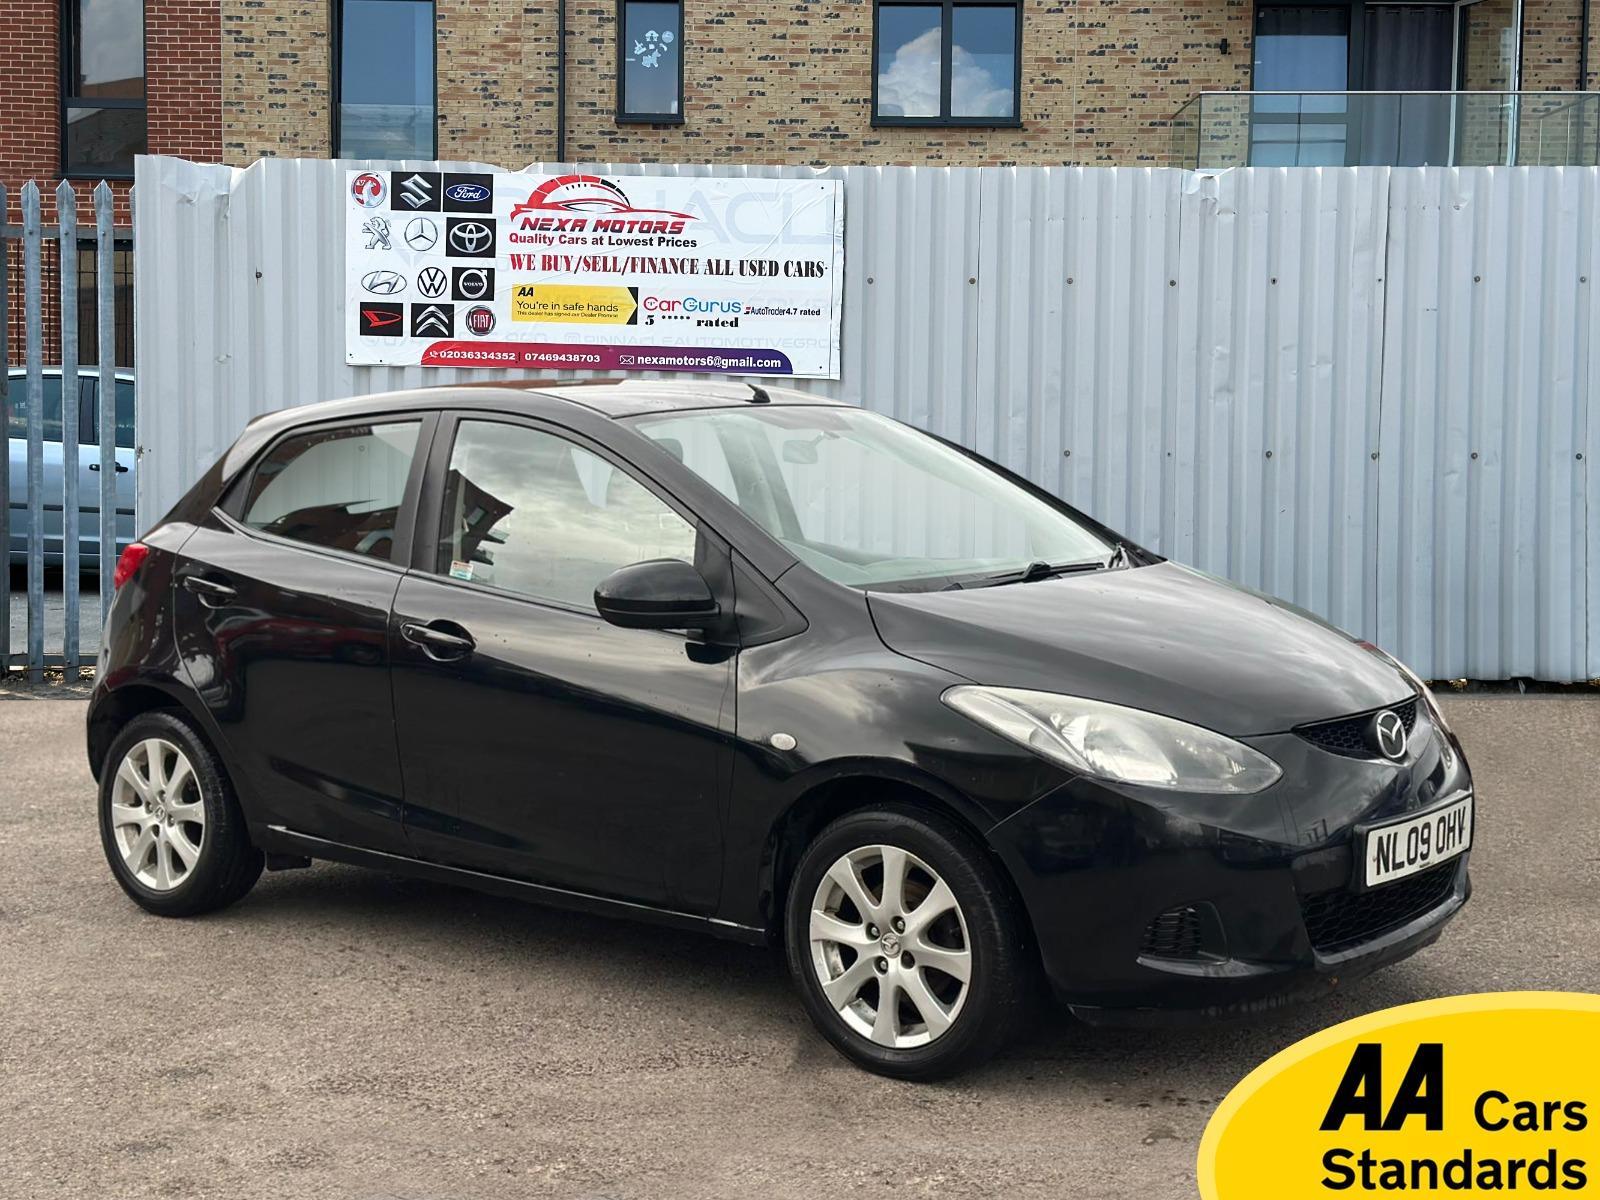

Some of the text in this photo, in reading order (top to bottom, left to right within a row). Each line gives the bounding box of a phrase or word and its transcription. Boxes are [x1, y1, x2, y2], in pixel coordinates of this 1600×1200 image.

[454, 186, 481, 199] Ford
[520, 217, 685, 235] NEXA MOTORS
[509, 233, 697, 248] Quality Cars at Lowest Prices
[510, 254, 825, 278] WE BUY/SELL/FINANCE ALL USED CARS
[518, 287, 534, 297] AA
[516, 300, 619, 312] You're in safe hands
[643, 296, 742, 313] CarGurus
[800, 308, 821, 316] rated
[474, 314, 490, 328] FIAT
[645, 315, 739, 328] 5 rated
[440, 351, 600, 362] 02036334352 07469438703
[638, 356, 781, 368] nexamotors6@gmail.com
[1376, 806, 1466, 876] NL09 OHV
